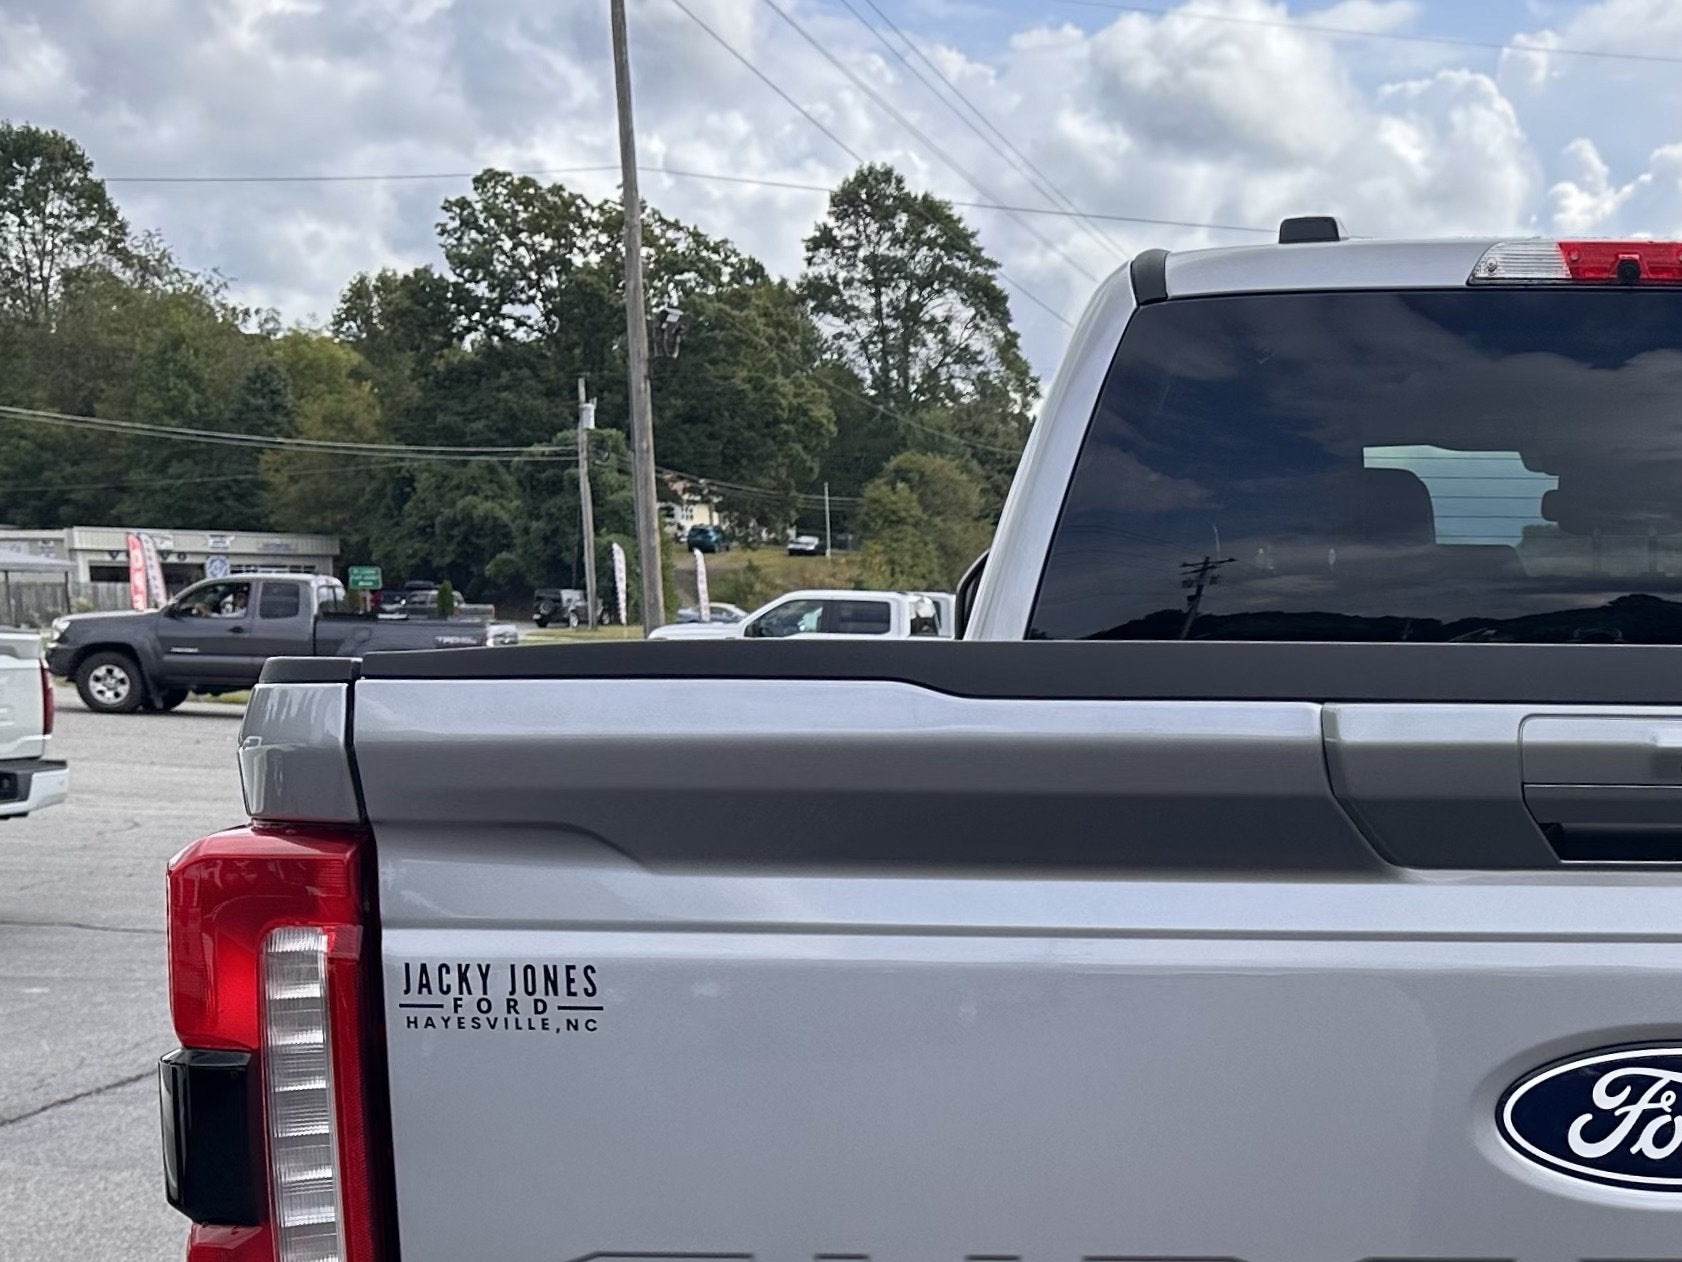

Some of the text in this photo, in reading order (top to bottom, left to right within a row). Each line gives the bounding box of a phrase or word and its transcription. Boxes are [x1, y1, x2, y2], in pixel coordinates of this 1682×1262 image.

[403, 962, 598, 997] JACKY JONES
[453, 998, 548, 1015] FORD
